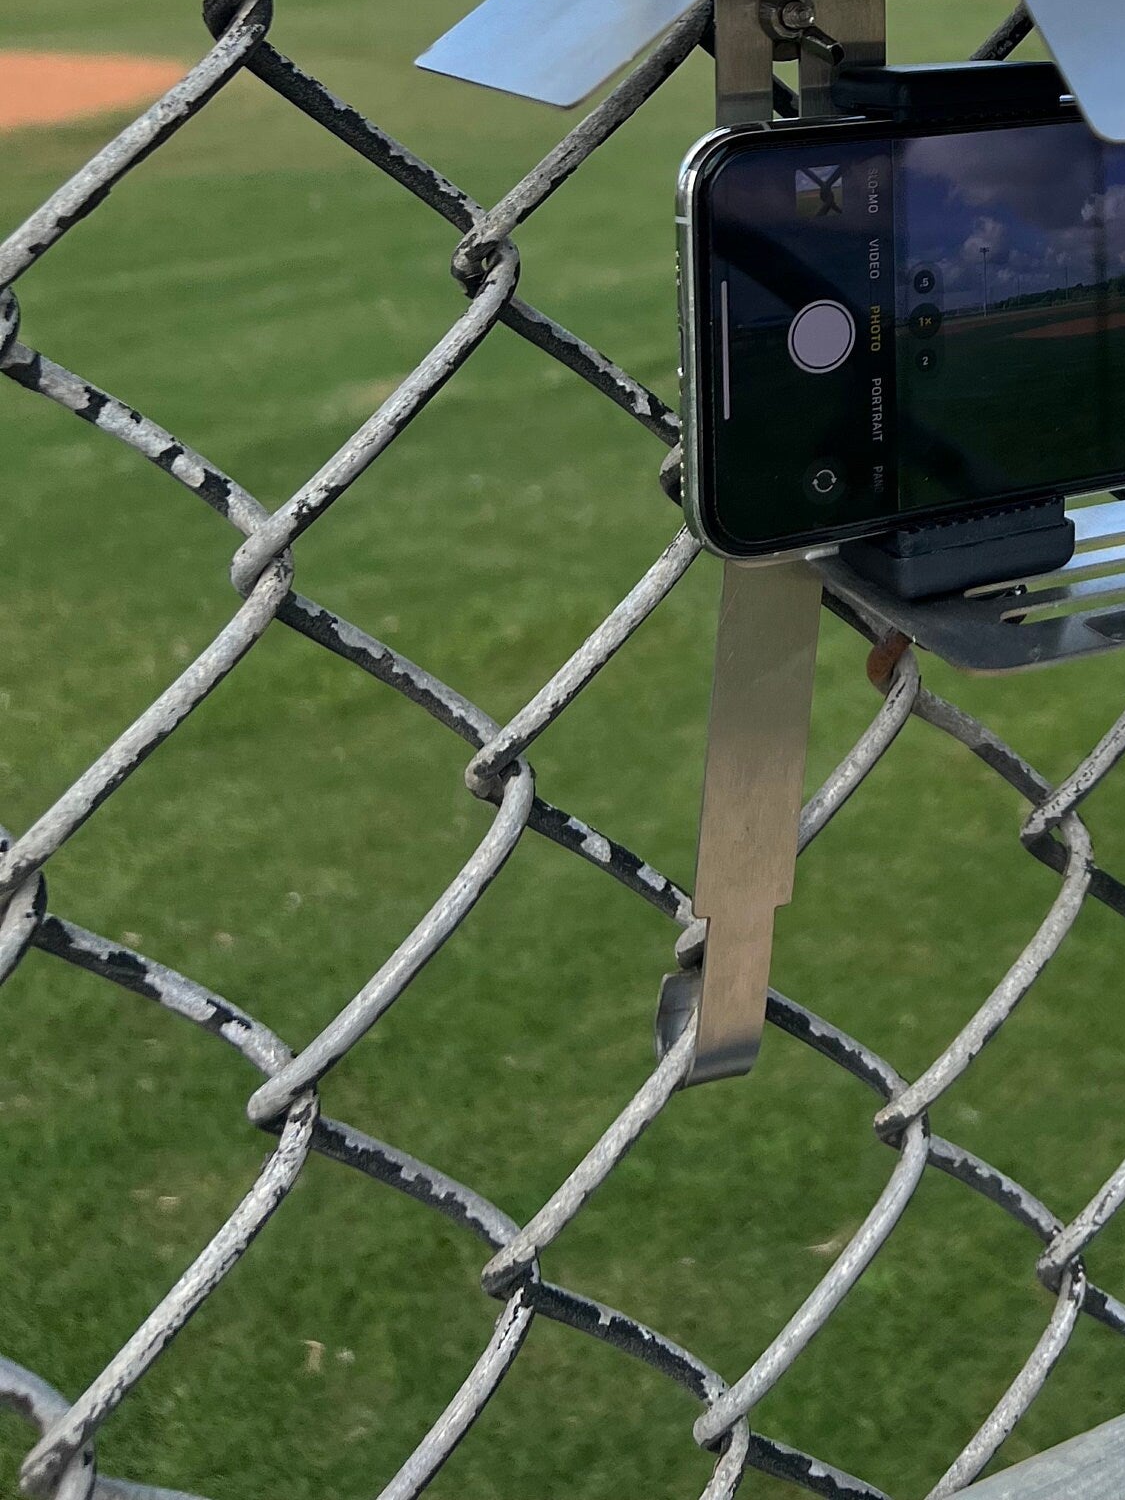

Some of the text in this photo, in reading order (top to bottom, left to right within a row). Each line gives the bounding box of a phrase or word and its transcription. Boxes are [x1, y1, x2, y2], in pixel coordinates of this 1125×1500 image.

[869, 238, 880, 279] VIDEO
[870, 305, 881, 352] PHOTO
[922, 356, 929, 366] 2
[871, 377, 883, 442] PORTRAIT
